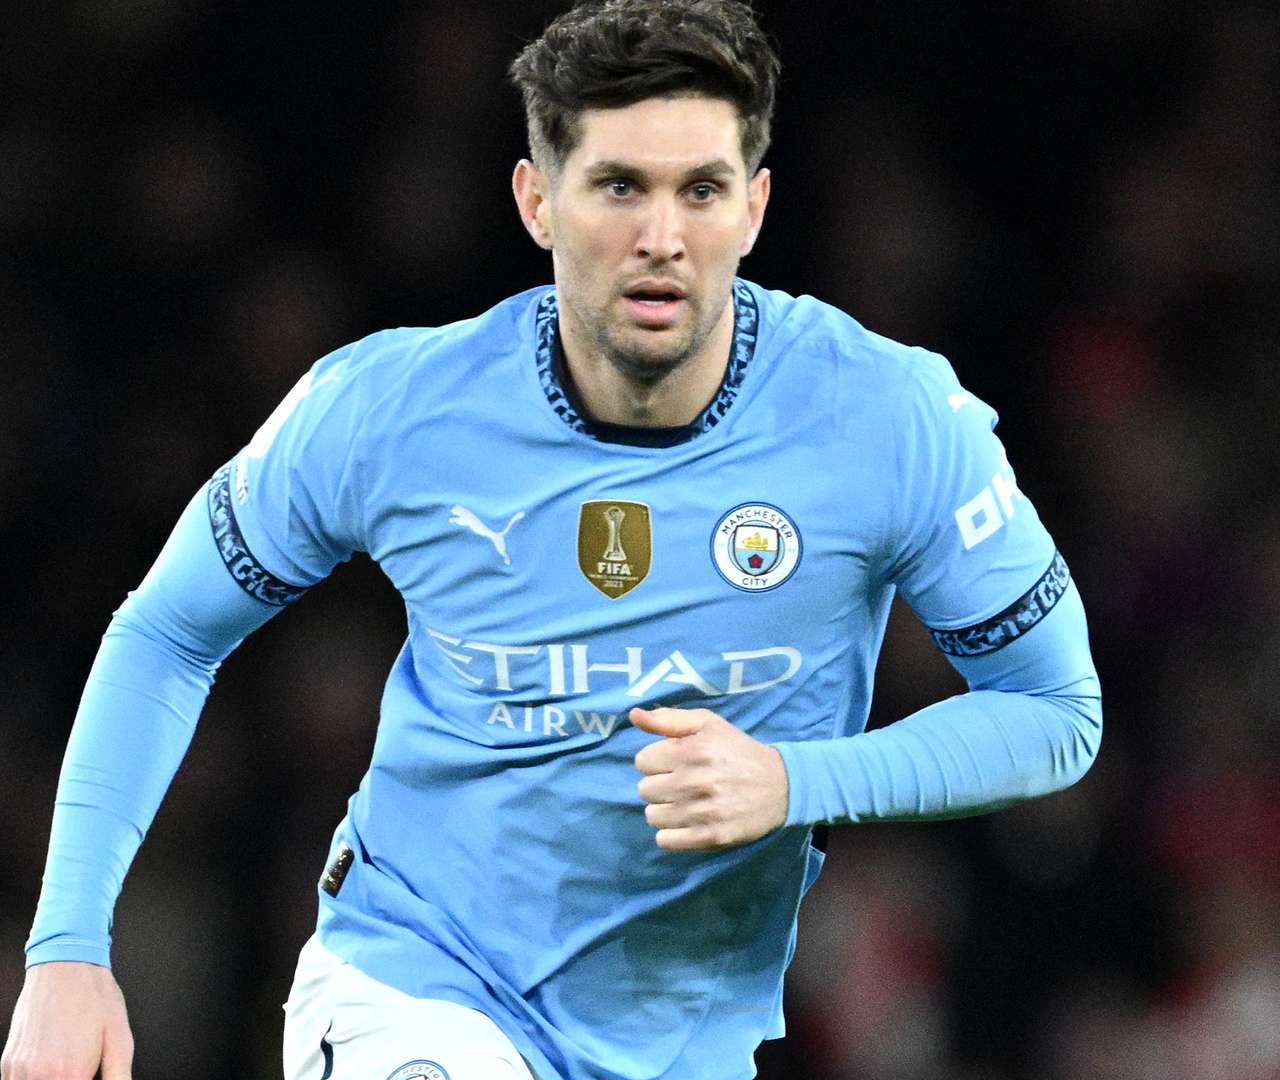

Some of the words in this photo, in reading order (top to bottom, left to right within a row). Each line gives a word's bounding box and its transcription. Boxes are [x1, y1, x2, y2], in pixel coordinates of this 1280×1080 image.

[722, 509, 793, 539] MANCHESTER
[597, 562, 631, 576] FIFA
[742, 577, 768, 586] CITY
[425, 627, 803, 698] ETIHAD
[487, 701, 617, 738] AIRW
